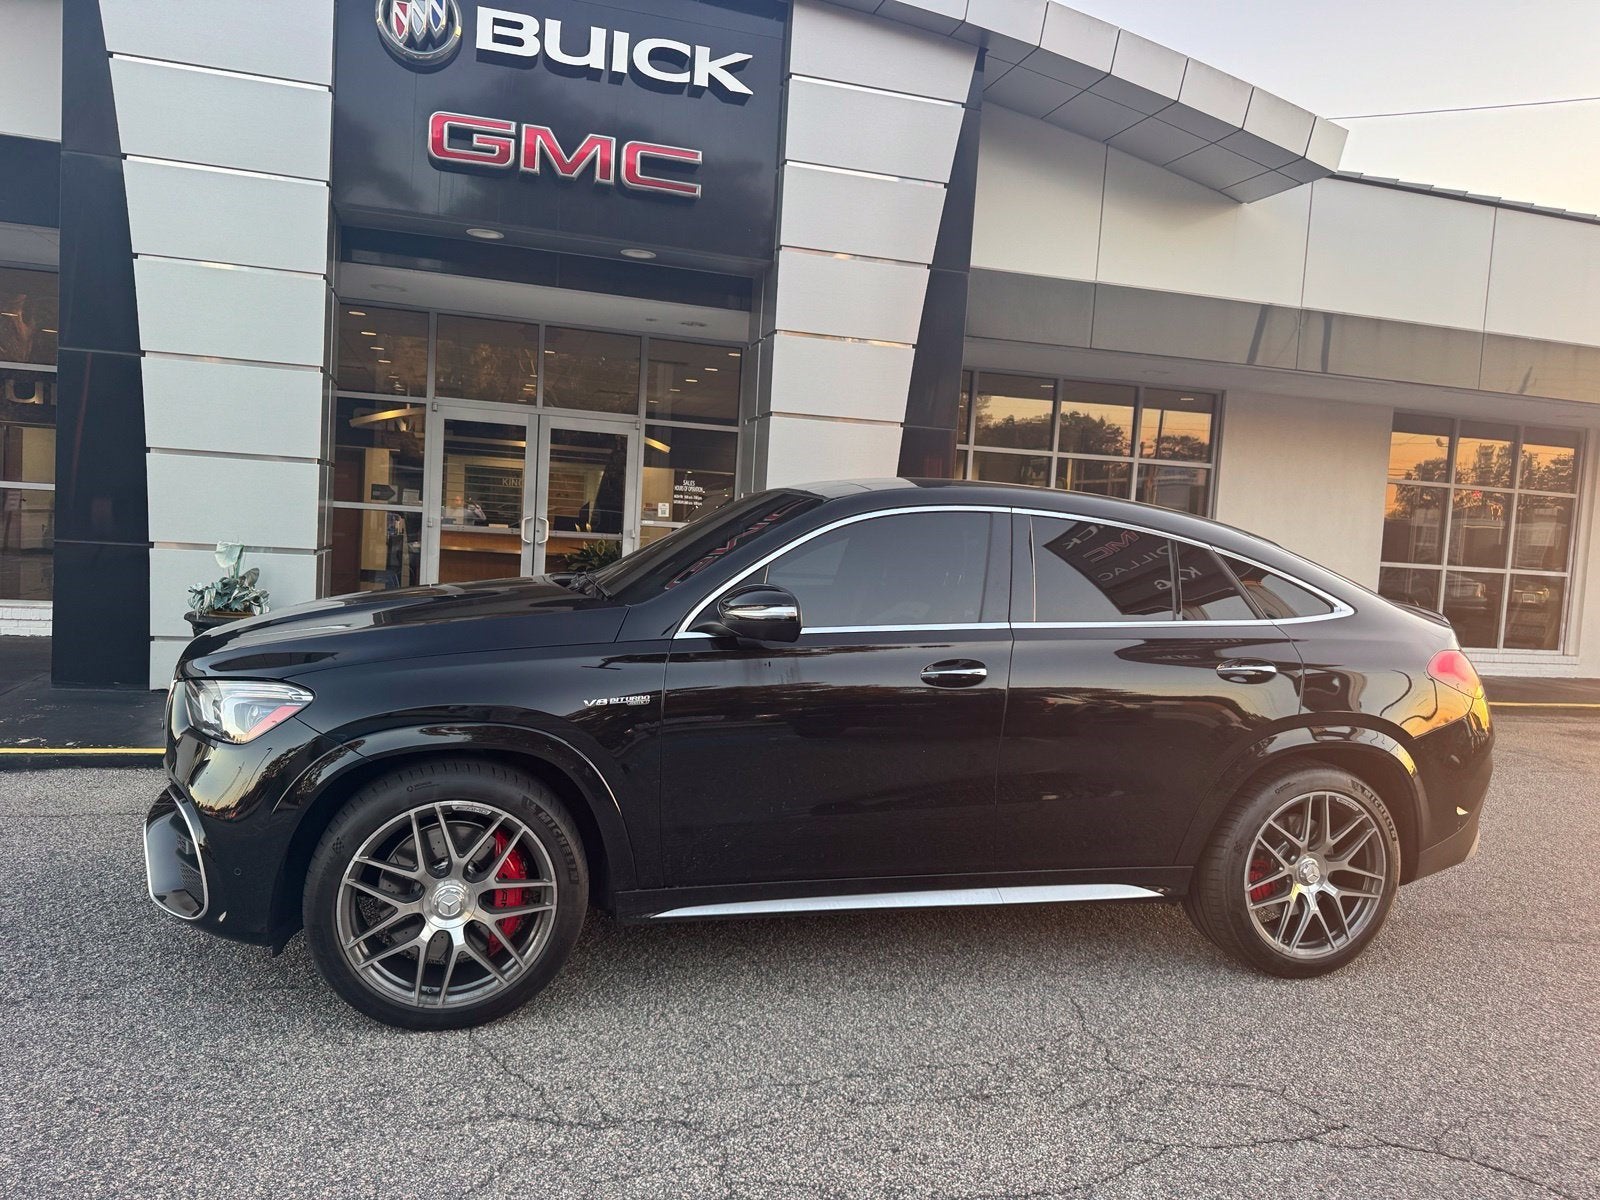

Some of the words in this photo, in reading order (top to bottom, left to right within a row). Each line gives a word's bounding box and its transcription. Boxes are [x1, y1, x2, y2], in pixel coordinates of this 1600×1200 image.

[476, 5, 753, 95] BUICK
[428, 111, 702, 199] GMC
[583, 698, 608, 707] V8
[538, 812, 580, 885] MICHELIN
[1363, 789, 1397, 841] MICHELIN
